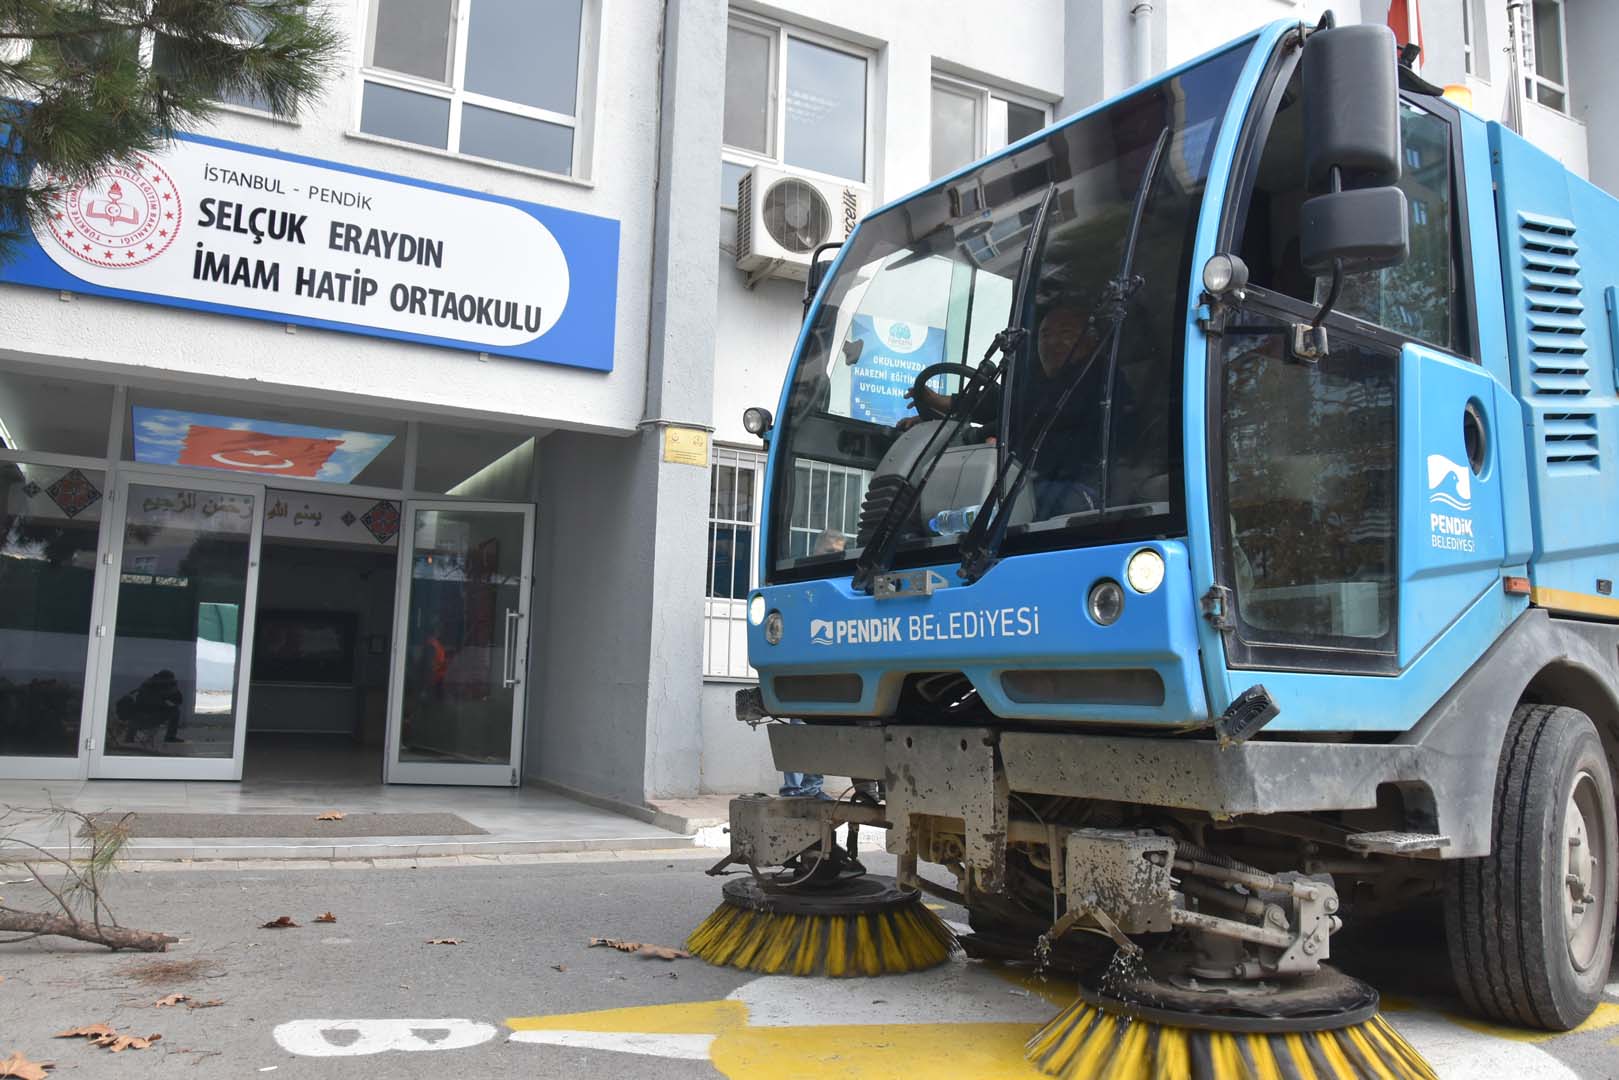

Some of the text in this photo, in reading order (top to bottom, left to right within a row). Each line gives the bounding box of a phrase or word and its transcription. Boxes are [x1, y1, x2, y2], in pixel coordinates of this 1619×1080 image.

[204, 163, 285, 194] İSTANBUL
[308, 185, 373, 211] PENDİK
[197, 197, 444, 269] SELÇUK ERAYDIN
[192, 241, 542, 334] İMAM HATİP ORTAOKULU
